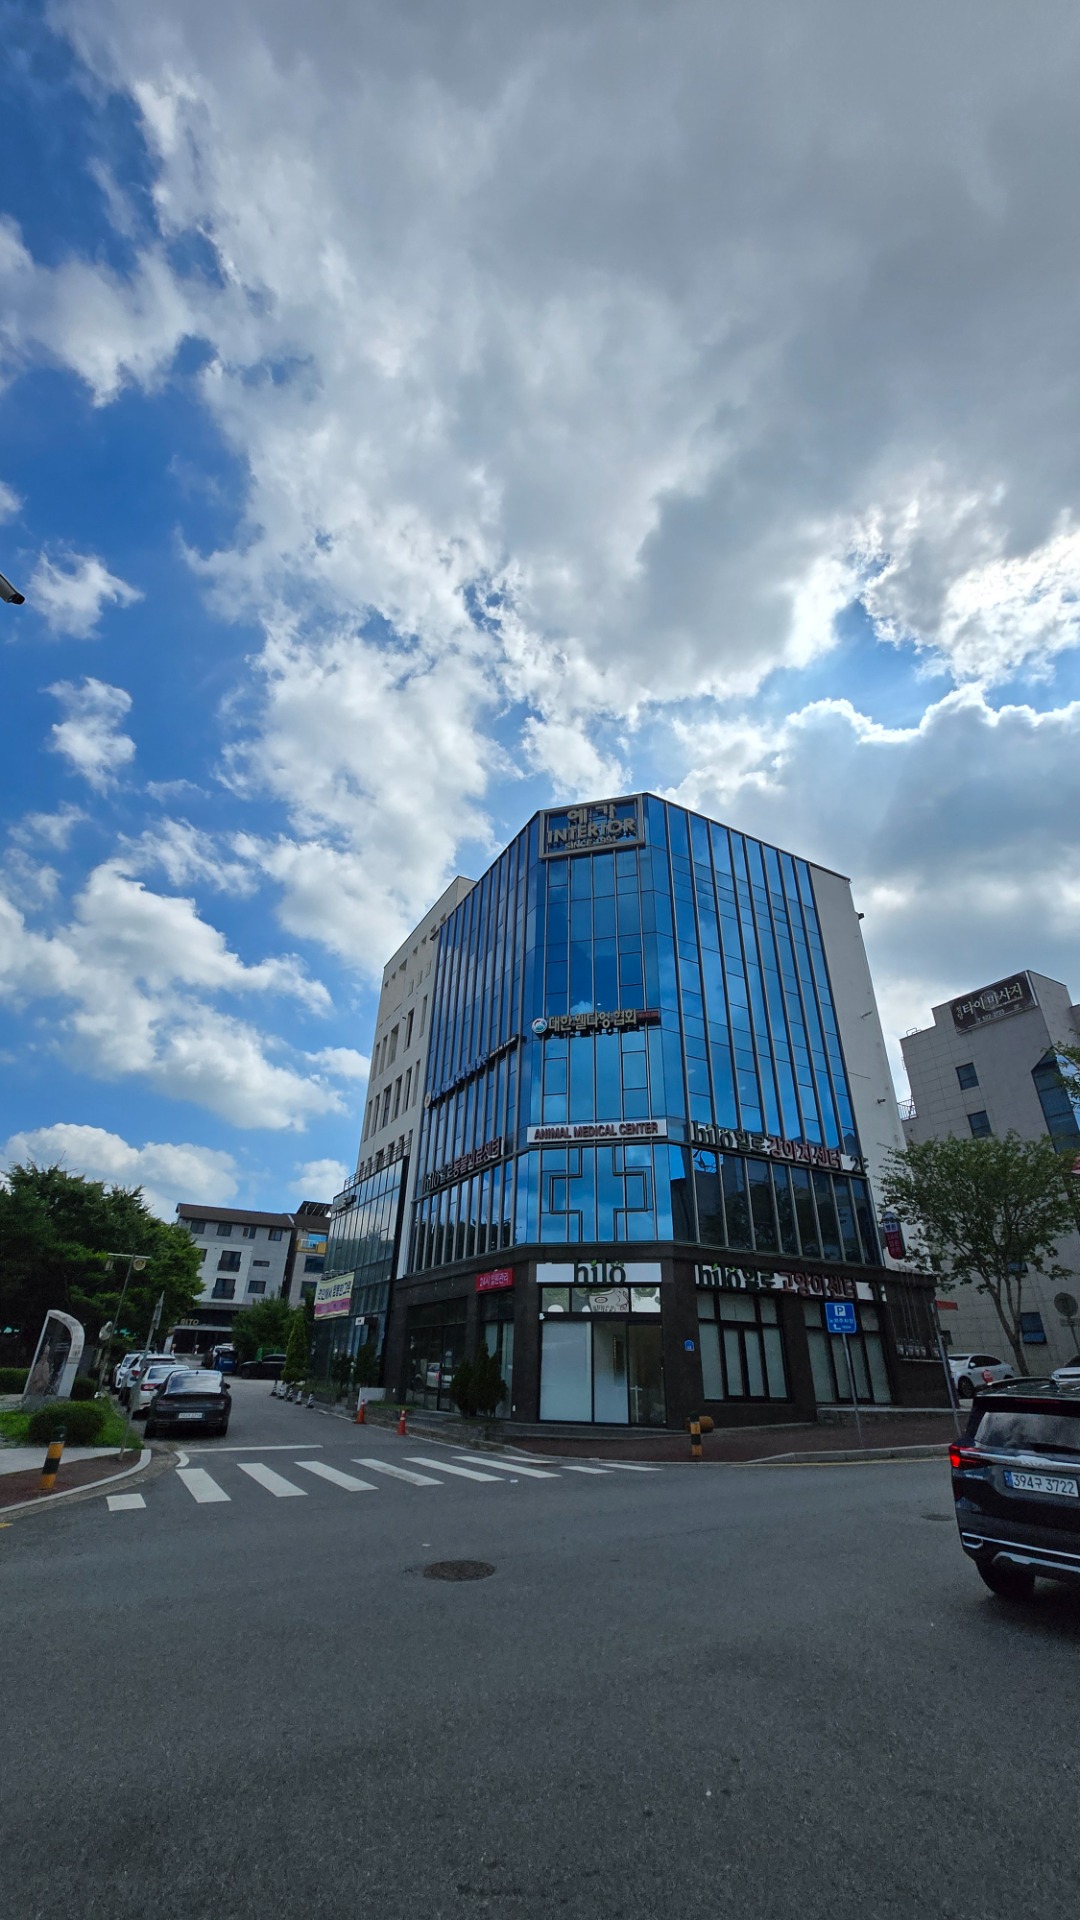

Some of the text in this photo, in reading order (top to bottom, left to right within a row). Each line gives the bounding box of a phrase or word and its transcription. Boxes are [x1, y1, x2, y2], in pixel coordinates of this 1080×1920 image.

[547, 818, 637, 844] INTERIOR
[565, 838, 593, 850] SINCE
[534, 1121, 659, 1140] ANIMAL MEDICAL CENTER
[766, 1136, 844, 1172] 강아지센터
[573, 1259, 626, 1284] hilo
[778, 1270, 860, 1302] 고양이센터
[836, 1306, 844, 1316] P
[1013, 1474, 1076, 1495] 394구 3722
